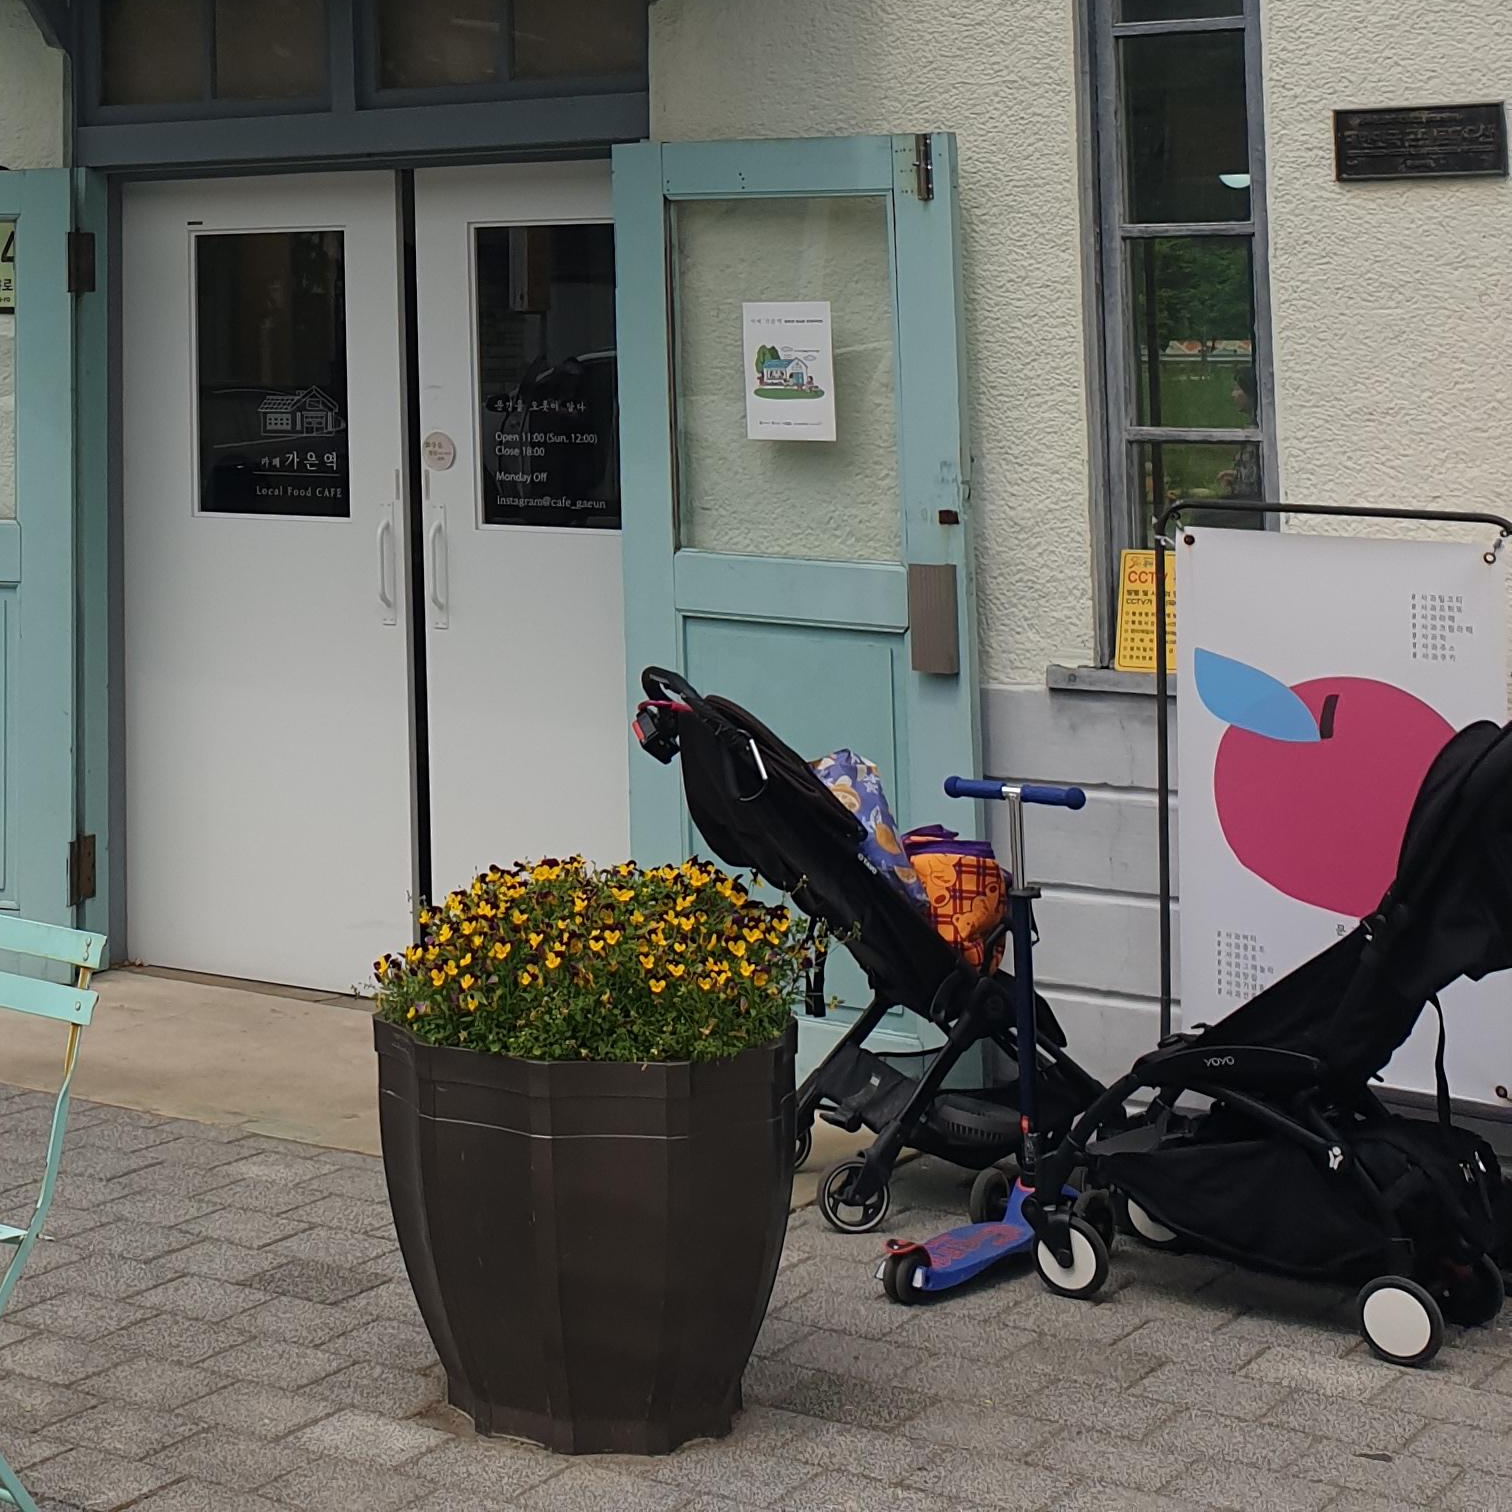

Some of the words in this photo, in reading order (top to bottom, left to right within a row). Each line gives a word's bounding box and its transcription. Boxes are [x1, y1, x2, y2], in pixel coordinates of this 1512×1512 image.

[495, 431, 519, 443] Open
[522, 432, 545, 442] 11:00
[571, 433, 598, 444] 12:00)
[495, 445, 520, 456] Close
[522, 446, 545, 456] 18:00
[284, 450, 337, 471] 가은역
[496, 471, 531, 484] Monday
[533, 472, 548, 482] Off
[256, 485, 283, 497] Local
[287, 486, 312, 497] Food
[316, 487, 342, 498] CAFE
[1203, 1055, 1235, 1067] YOYO
